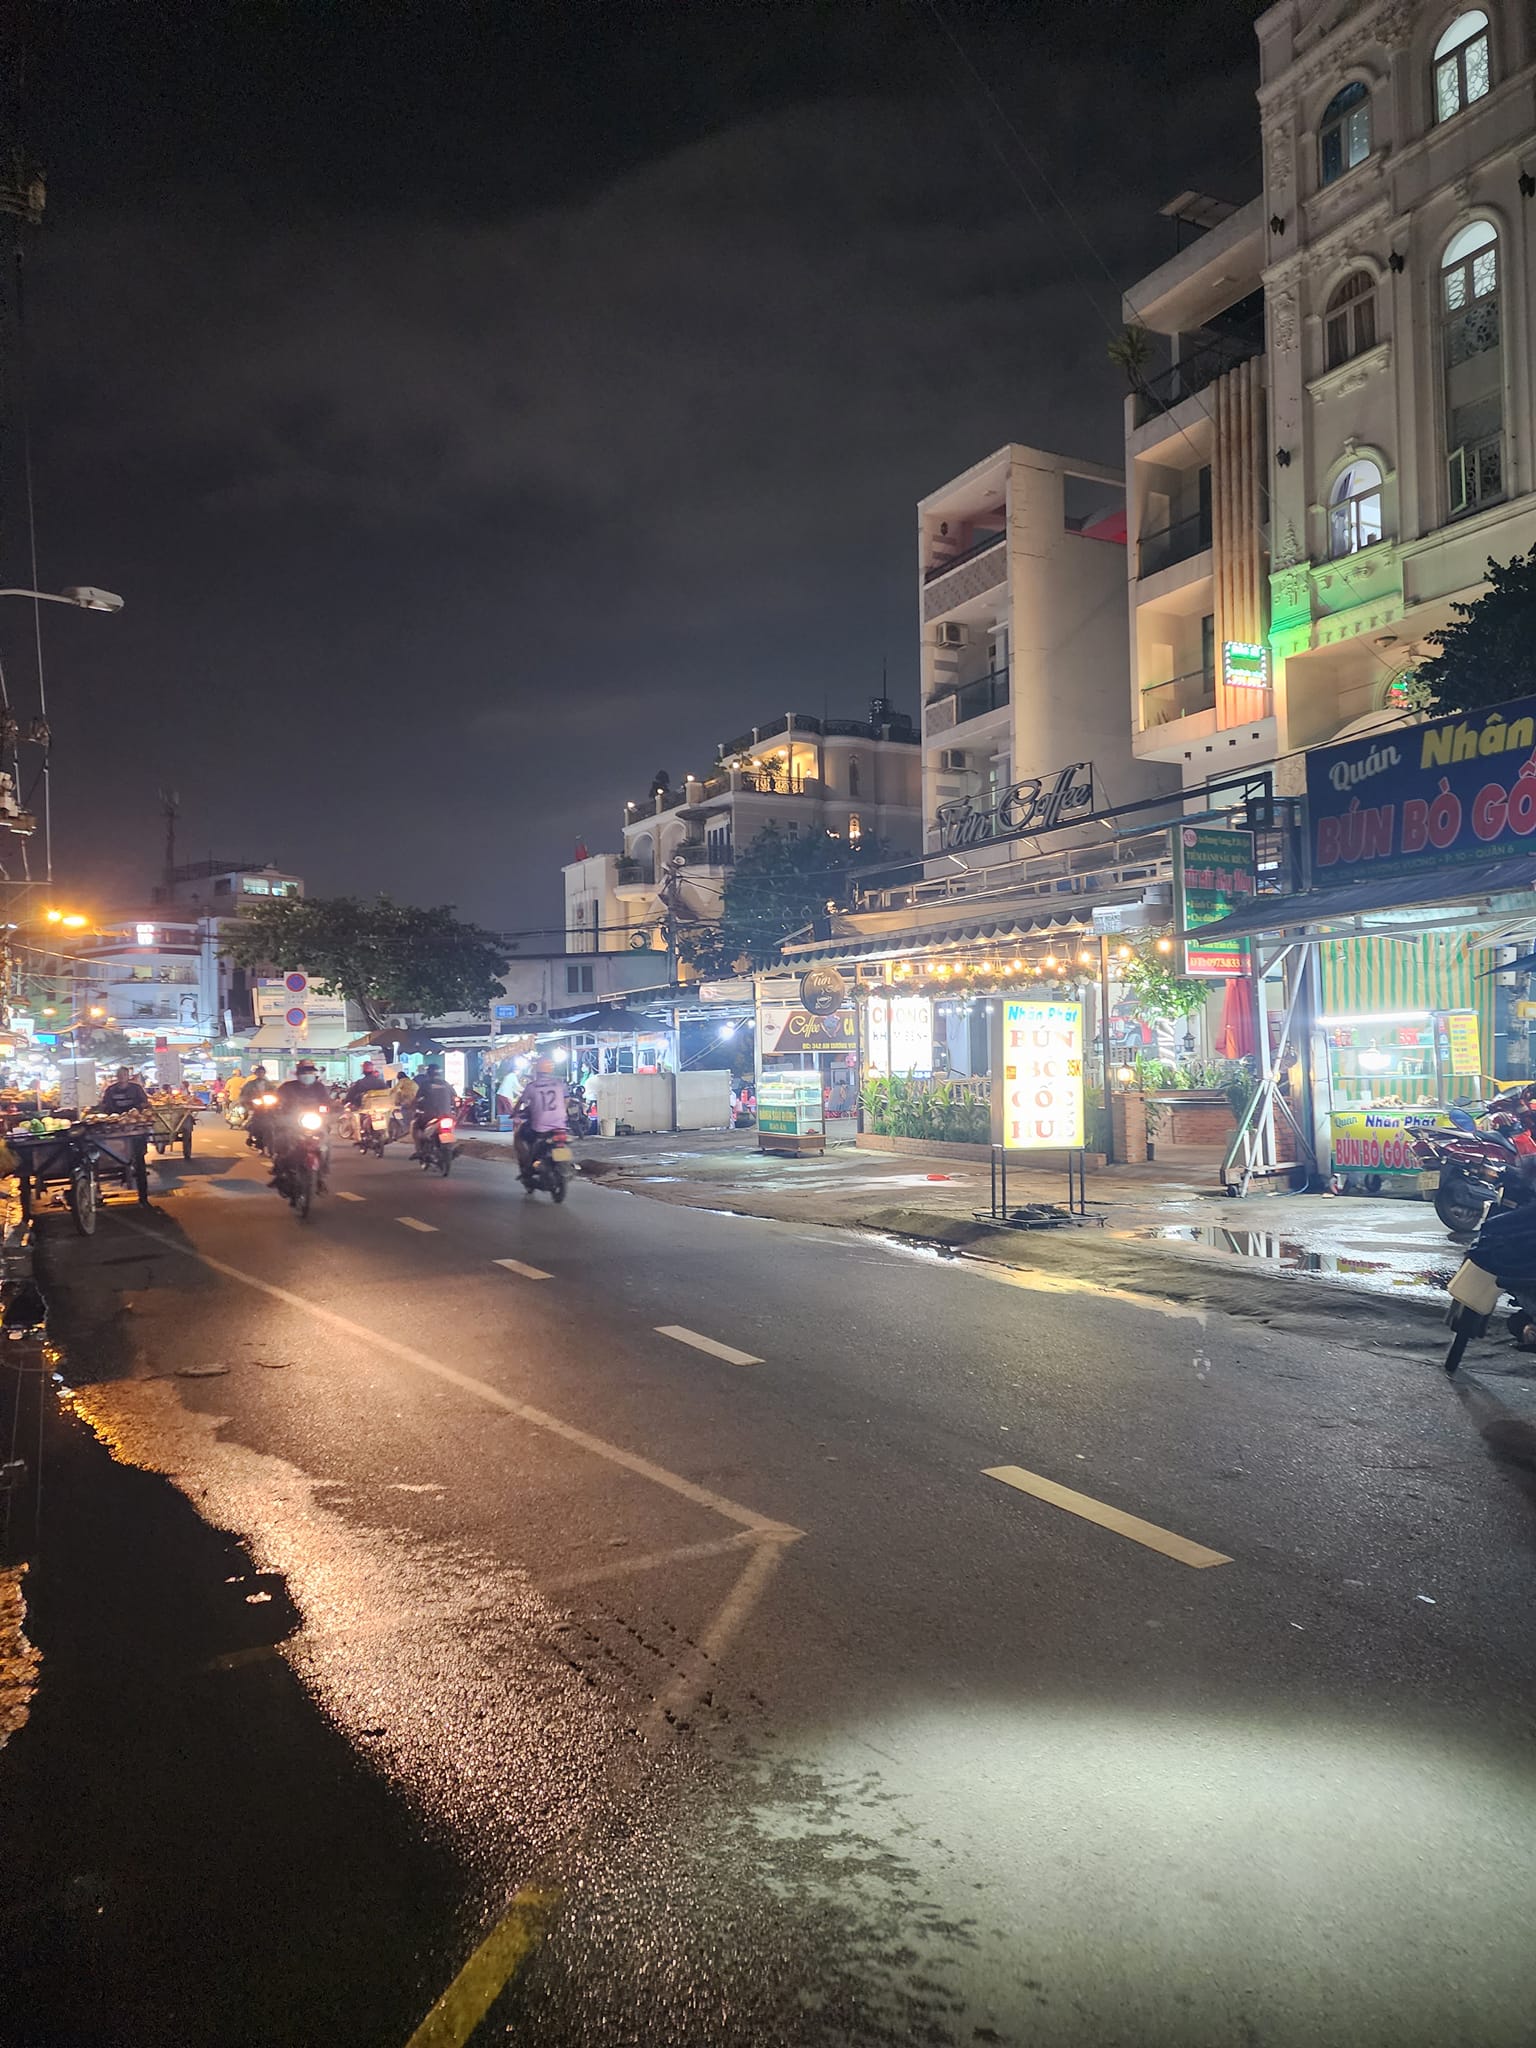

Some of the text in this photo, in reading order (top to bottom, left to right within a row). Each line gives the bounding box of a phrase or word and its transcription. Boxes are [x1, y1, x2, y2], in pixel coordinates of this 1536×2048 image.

[1329, 712, 1535, 791] Quán Nhân
[997, 762, 1092, 832] Coffee
[1316, 796, 1395, 868] BÚN
[1401, 776, 1462, 849] BÒ
[1475, 845, 1503, 859] QUẬN
[1506, 845, 1515, 855] 6
[1008, 1005, 1078, 1022] Nhân Phát
[788, 1015, 821, 1039] Coffee
[1010, 1025, 1074, 1048] BÚN
[540, 1090, 557, 1113] 12
[1365, 1114, 1400, 1128] Nhân
[1404, 1115, 1437, 1127] Phát
[1335, 1131, 1361, 1166] BÚN
[1362, 1131, 1380, 1168] BÒ
